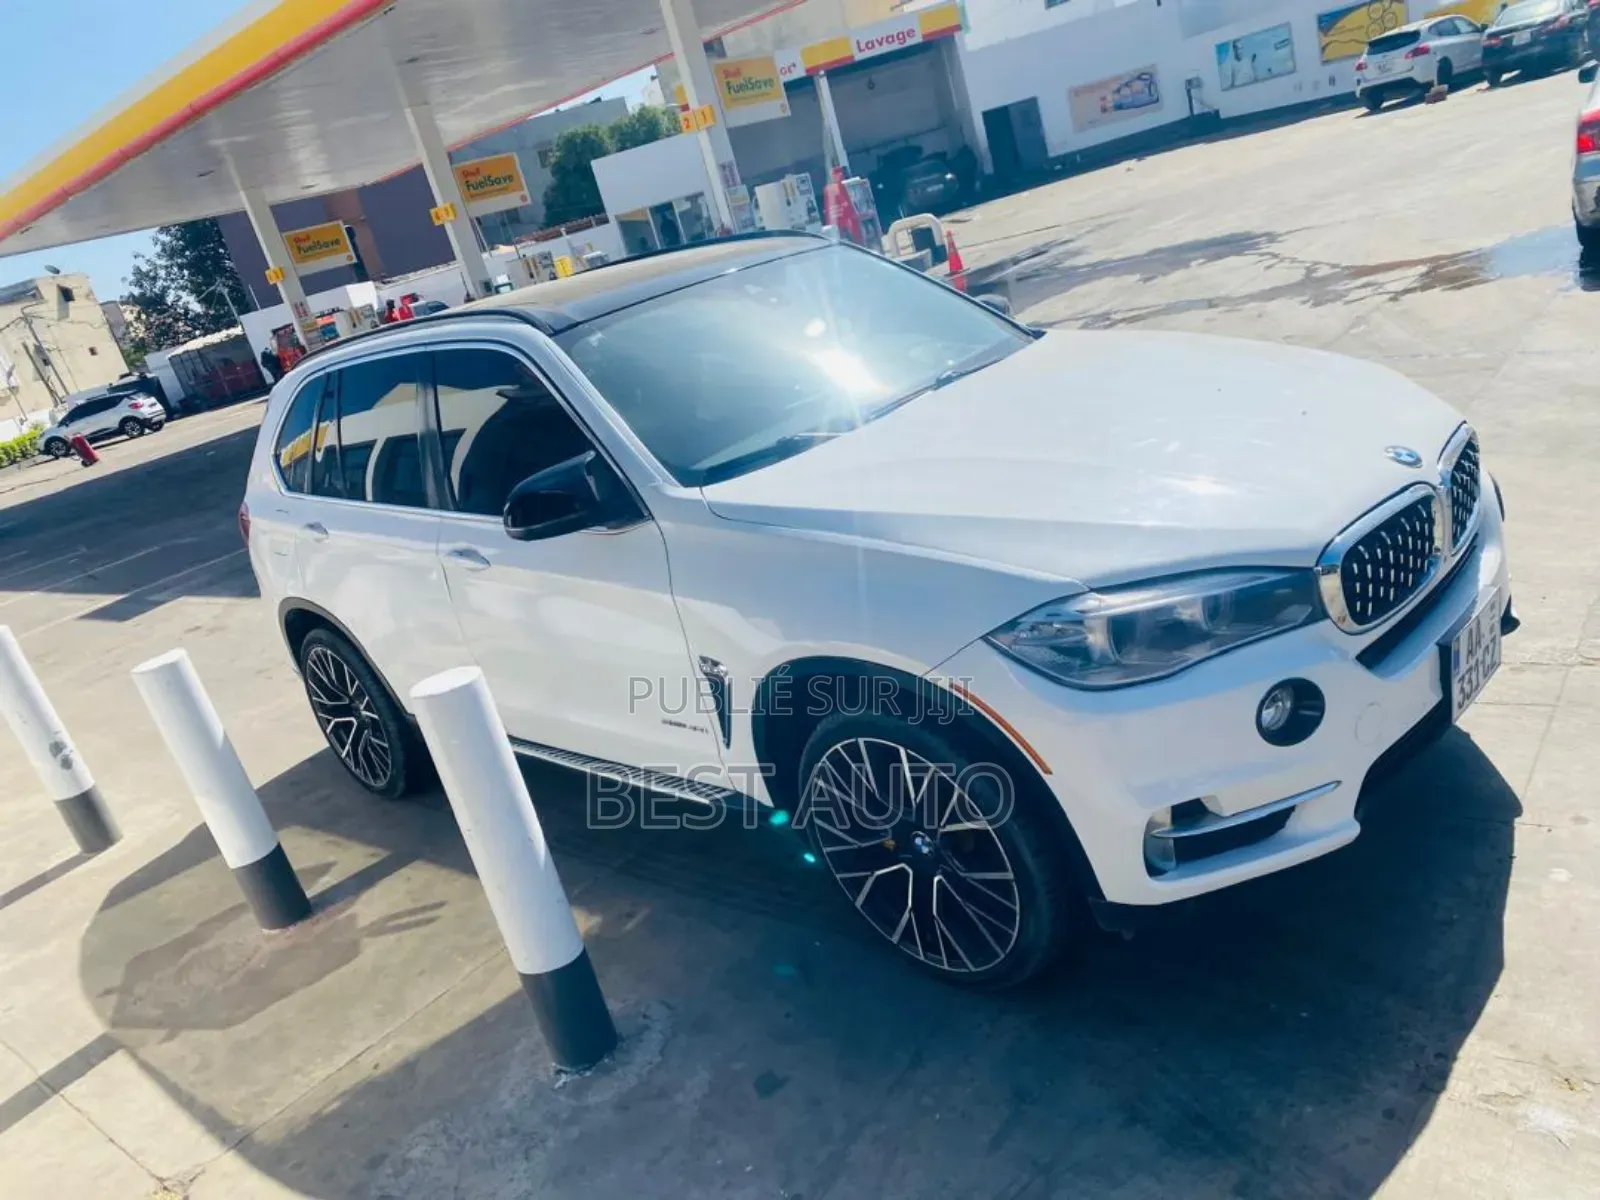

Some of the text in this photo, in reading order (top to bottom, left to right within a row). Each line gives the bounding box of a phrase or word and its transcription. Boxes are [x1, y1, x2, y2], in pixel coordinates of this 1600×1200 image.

[856, 28, 916, 53] Lavage
[725, 76, 774, 95] FuelSave
[683, 110, 707, 129] 2 1
[465, 174, 514, 191] FuelSave
[296, 238, 341, 254] FuelSave
